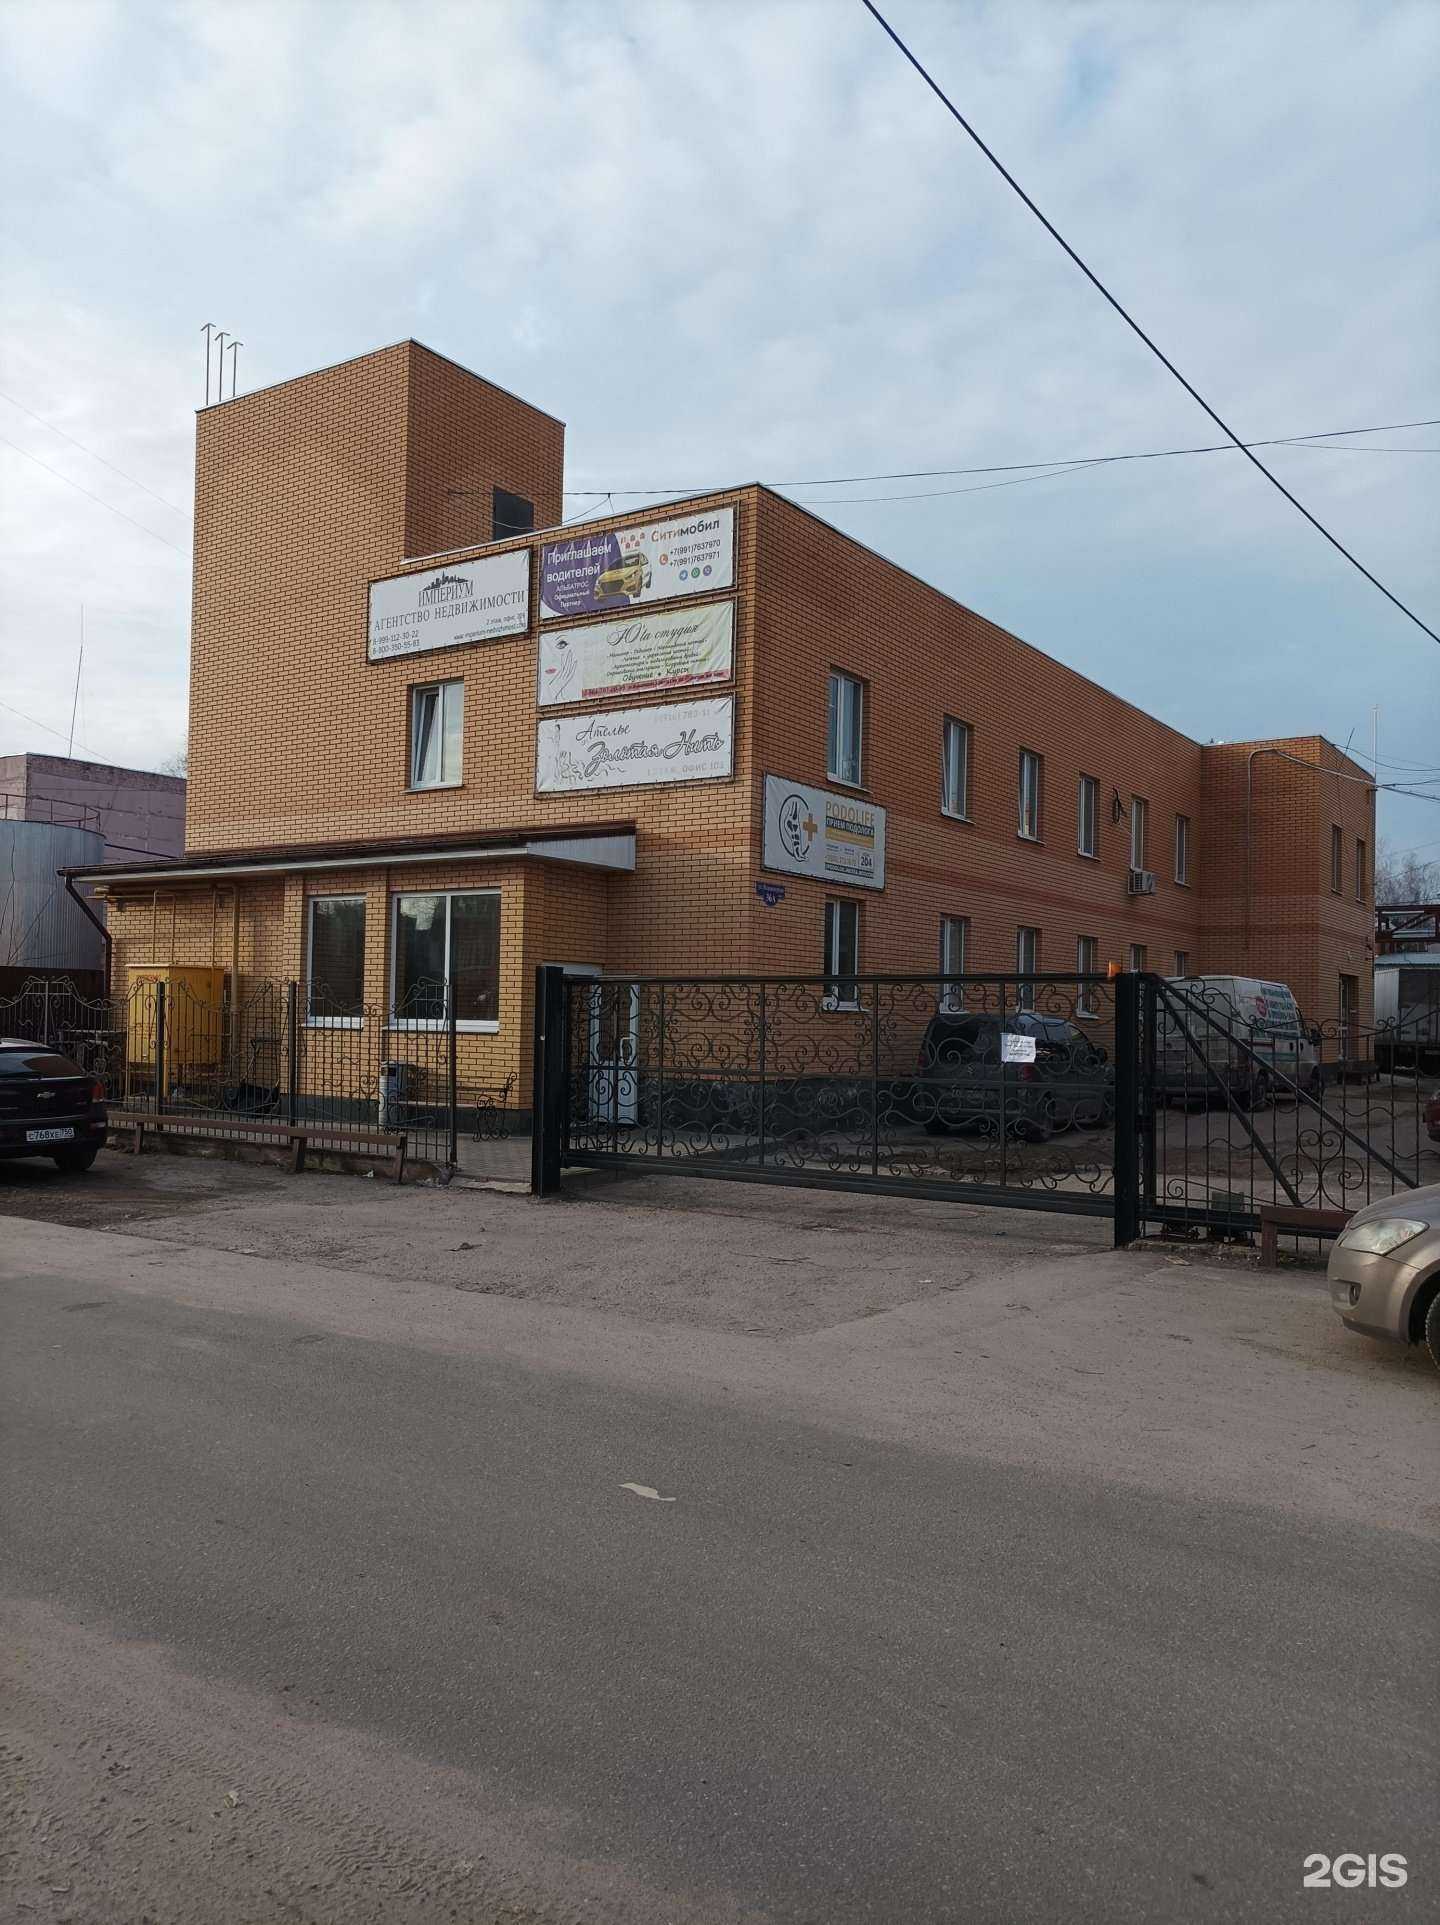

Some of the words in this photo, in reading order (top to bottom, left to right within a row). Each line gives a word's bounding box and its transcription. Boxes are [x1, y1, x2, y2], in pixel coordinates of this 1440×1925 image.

[651, 519, 720, 543] Ситимобил
[547, 542, 612, 565] Приглашаем
[546, 562, 600, 583] водителей
[418, 579, 474, 608] ИМПЕРИУМ
[374, 610, 430, 632] АГЕНТСТВО
[434, 590, 525, 620] НЕДВИЖИМОСТИ
